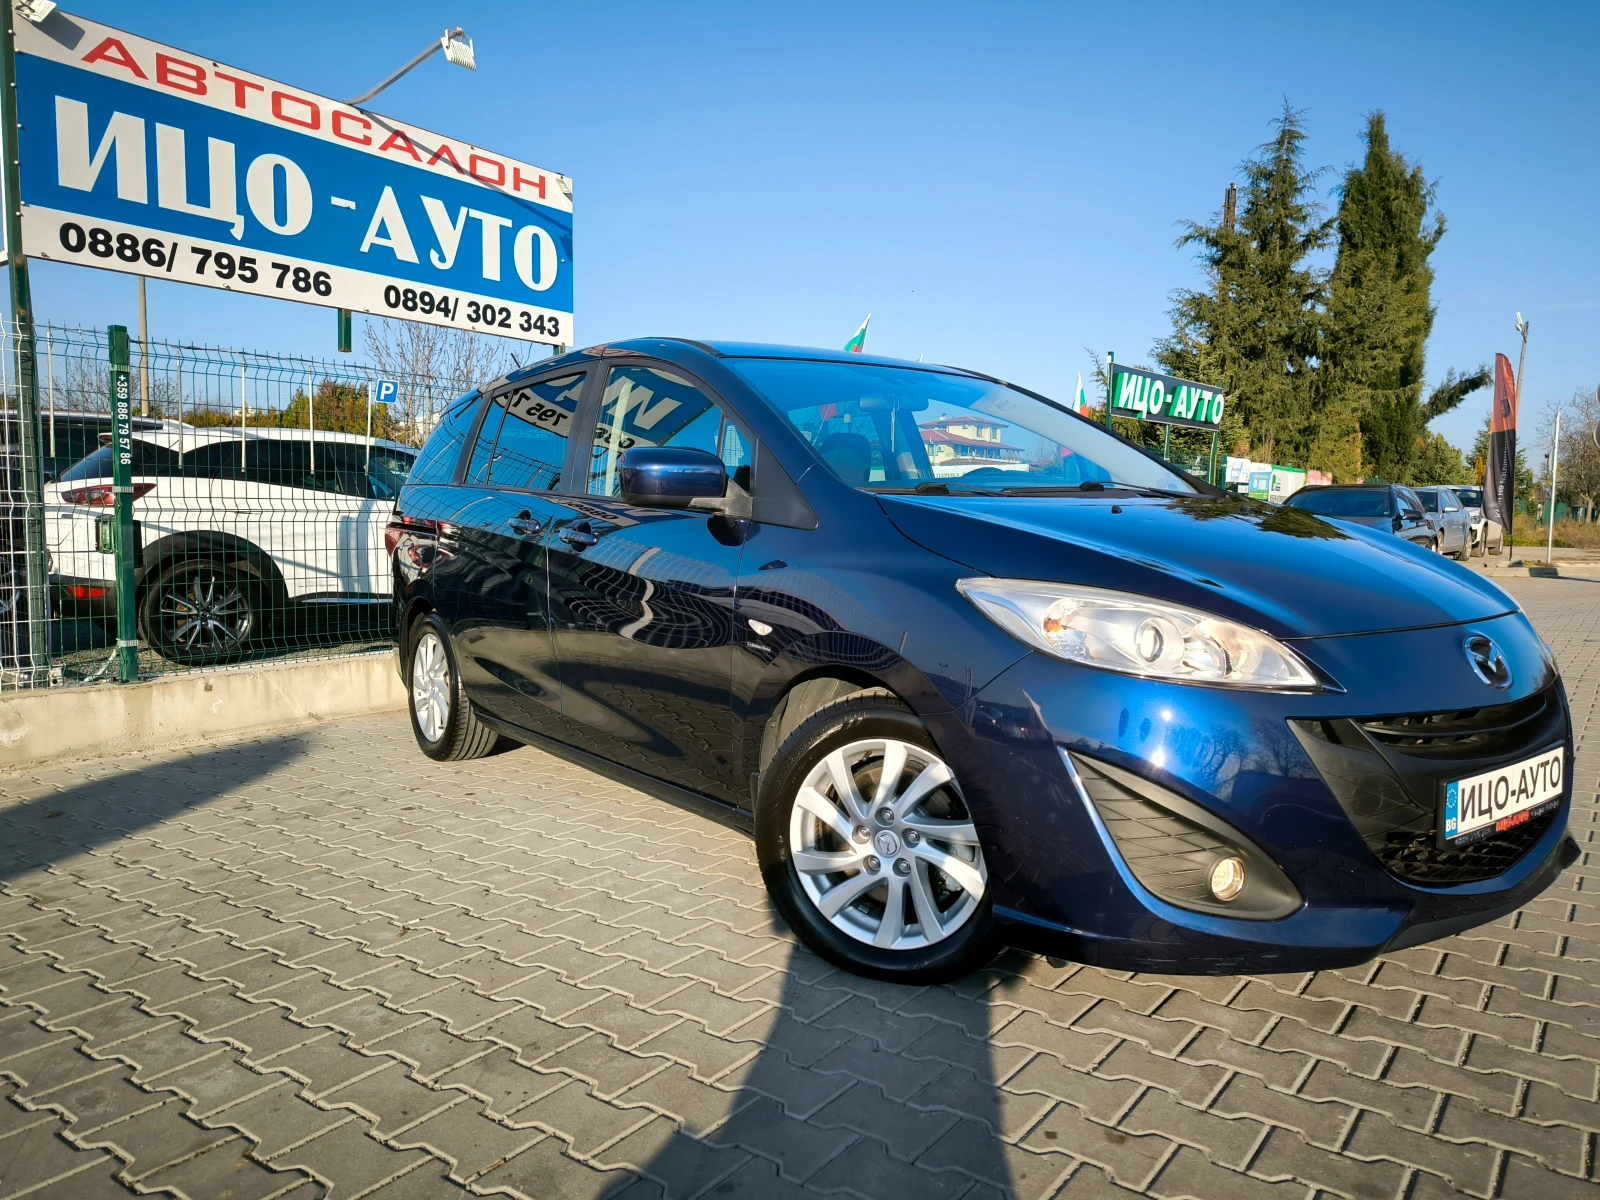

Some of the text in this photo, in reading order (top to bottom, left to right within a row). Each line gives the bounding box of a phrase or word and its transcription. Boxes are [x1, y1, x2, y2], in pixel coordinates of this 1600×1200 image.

[81, 37, 547, 200] АВТОСАЛОН
[59, 222, 560, 338] 0886/ 795 786 0894/ 302 343
[117, 375, 131, 465] +359 886 79 57 86
[380, 382, 395, 400] P
[1114, 372, 1224, 425] ИЦО-АУТО
[1460, 755, 1561, 823] ИЦО-АУТО
[1445, 817, 1457, 832] BG
